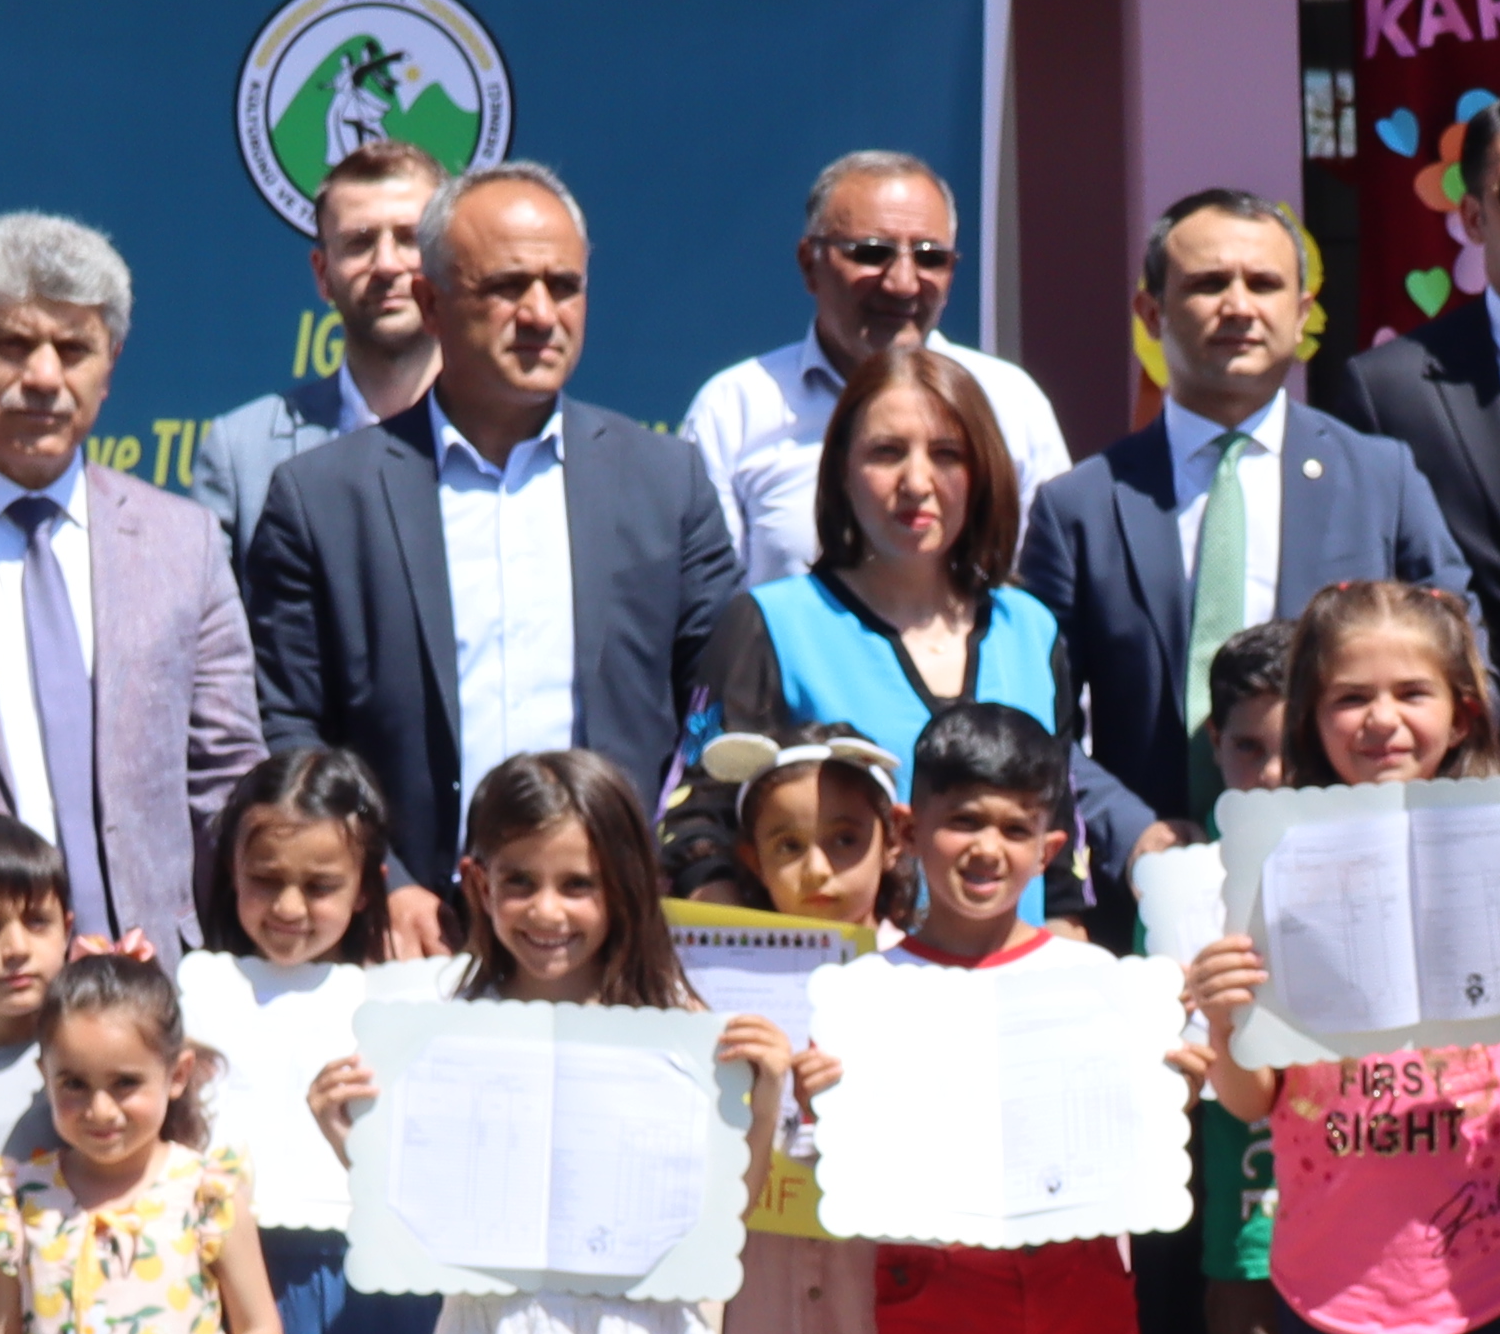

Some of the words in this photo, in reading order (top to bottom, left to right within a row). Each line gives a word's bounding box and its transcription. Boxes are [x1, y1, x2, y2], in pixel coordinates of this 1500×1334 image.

[86, 434, 143, 479] ve
[152, 419, 215, 488] TU
[1340, 1061, 1448, 1097] FIRST
[1325, 1108, 1466, 1157] SIGHT
